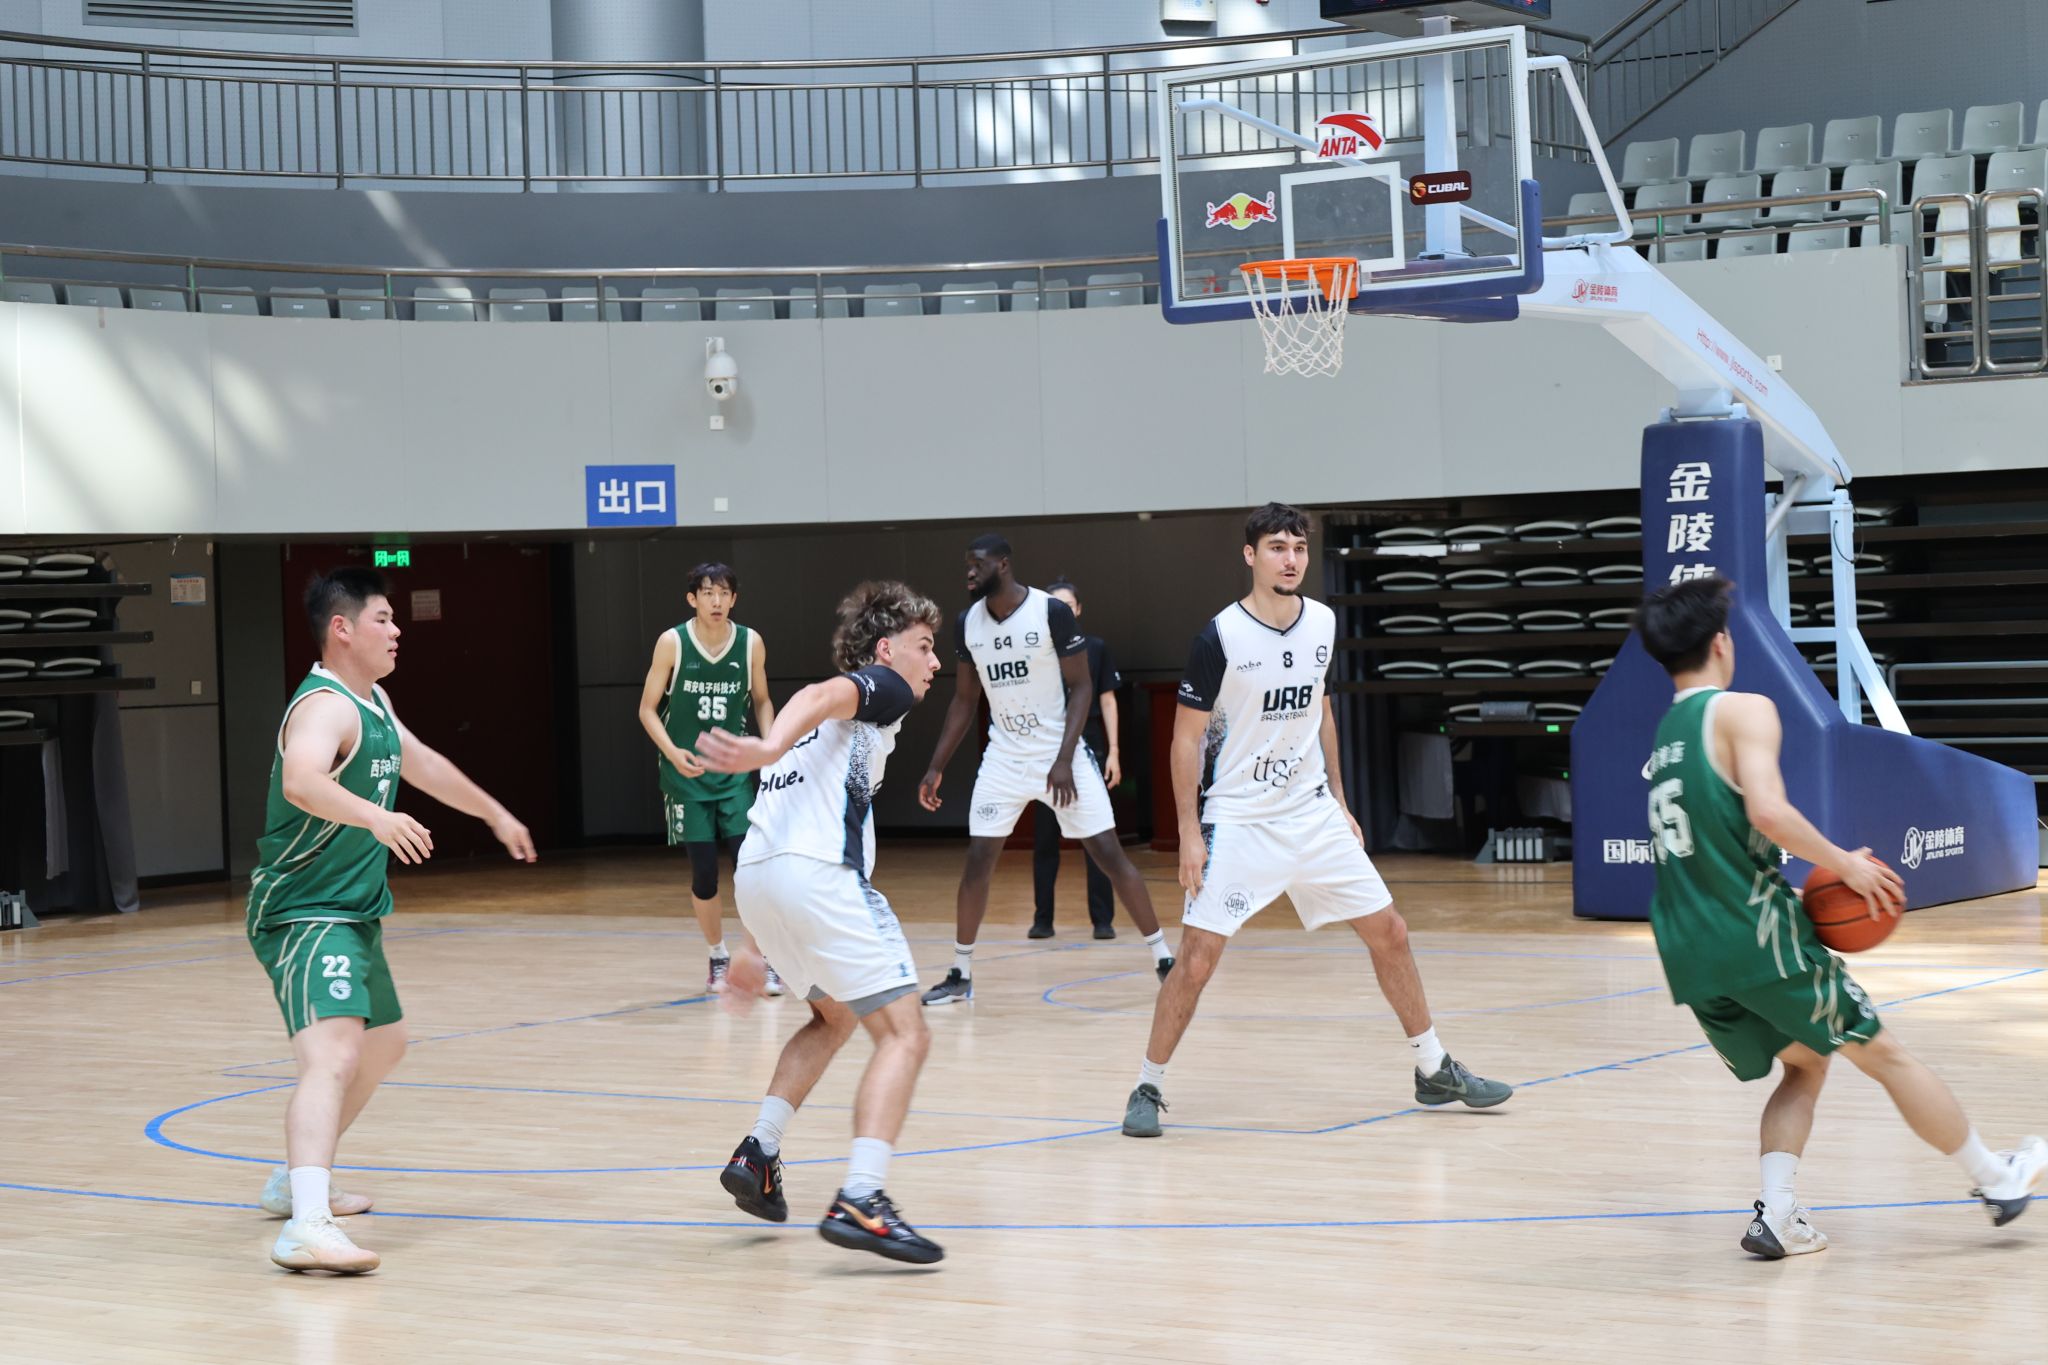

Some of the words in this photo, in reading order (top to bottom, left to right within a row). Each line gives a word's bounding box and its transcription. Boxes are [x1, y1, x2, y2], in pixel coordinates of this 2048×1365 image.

[1318, 136, 1357, 157] ANTA
[1427, 181, 1470, 194] CUBAL
[598, 478, 667, 514] 出口
[994, 636, 1013, 651] 64
[1282, 650, 1294, 668] 8
[986, 660, 1029, 682] URB
[697, 695, 728, 721] 35
[1262, 684, 1314, 713] URB
[999, 712, 1042, 736] itga
[1259, 709, 1308, 723] BASKETBALL
[1603, 839, 1657, 865] 国际
[321, 954, 352, 978] 22
